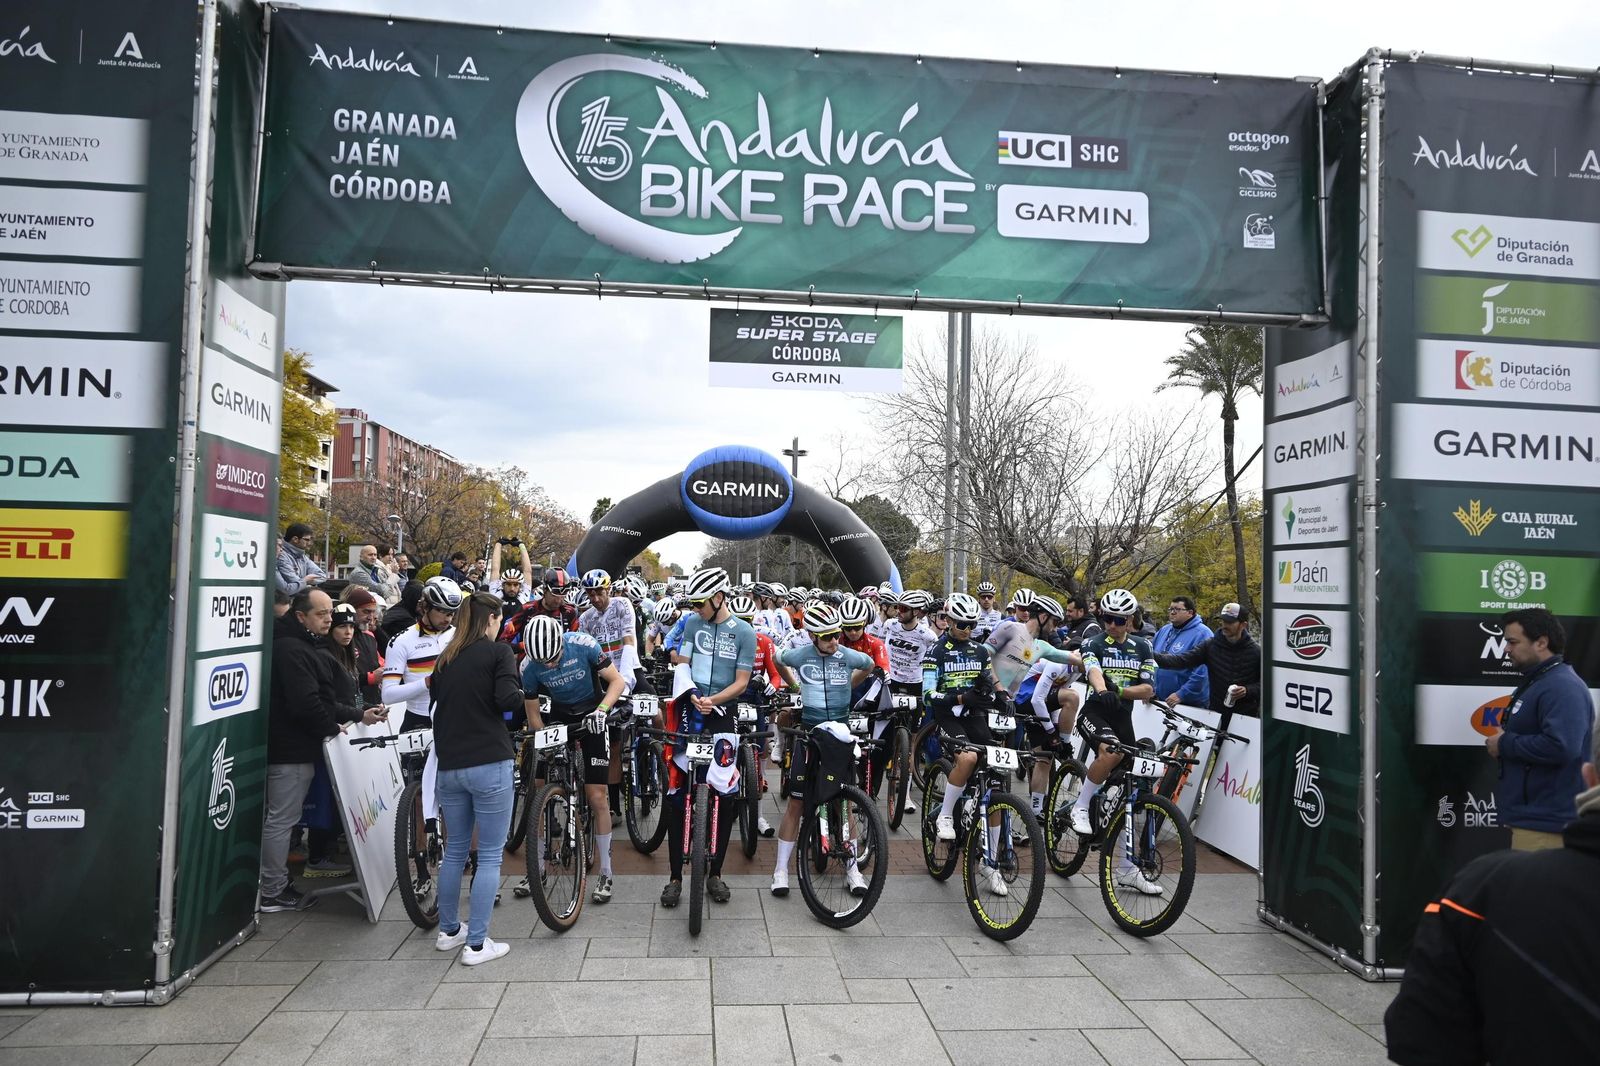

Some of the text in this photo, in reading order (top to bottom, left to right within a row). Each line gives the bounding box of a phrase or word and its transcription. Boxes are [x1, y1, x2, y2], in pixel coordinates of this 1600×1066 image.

[127, 60, 161, 69] Andalucía
[309, 43, 421, 77] Andalucía
[333, 108, 457, 140] GRANADA
[575, 96, 633, 181] 15
[637, 85, 975, 180] Andalucía
[1228, 131, 1290, 151] octagon
[1228, 143, 1260, 152] esedos
[19, 147, 89, 162] GRANADA
[330, 137, 400, 168] JAÉN
[1011, 138, 1119, 164] UCI SHC
[1412, 135, 1538, 177] Andalucía
[575, 154, 617, 165] YEARS
[329, 170, 452, 205] CÓRDOBA
[1239, 190, 1277, 198] CICLISMO
[640, 163, 997, 234] BIKE RACE BY
[1015, 202, 1132, 226] GARMIN
[10, 227, 47, 240] JAÉN
[1497, 236, 1570, 253] Diputación
[1497, 251, 1574, 266] de Granada
[1496, 306, 1546, 317] DIPUTACIÓN
[1496, 315, 1530, 325] DE JAÉN
[736, 327, 878, 345] SUPER STAGE
[772, 343, 842, 362] CÓRDOBA
[1500, 361, 1571, 377] Diputación
[772, 371, 841, 385] GARMIN
[1500, 377, 1572, 391] de Córdoba
[211, 382, 271, 425] GARMIN
[1274, 431, 1346, 463] GARMIN
[1434, 429, 1593, 462] GARMIN
[228, 464, 266, 489] IMDECO
[692, 480, 781, 498] GARMIN
[1297, 516, 1321, 524] Municipal
[1501, 511, 1577, 526] CAJA RURAL
[599, 524, 642, 538] garmin.com
[829, 531, 870, 544] garmin.com
[1297, 527, 1320, 536] Deportes
[1524, 526, 1556, 539] JAÉN
[1293, 560, 1328, 583] Jaén
[1316, 584, 1339, 593] INTERIOR
[211, 596, 253, 618] POWER
[1480, 601, 1506, 609] SPORT
[228, 618, 252, 639] ADE
[889, 639, 920, 652] KTM
[211, 671, 244, 703] CRUZ
[639, 701, 652, 713] 9-1
[898, 697, 910, 707] 6-1
[995, 716, 1009, 727] 4-2
[543, 729, 560, 744] 1-2
[1186, 725, 1201, 737] 4-1
[407, 733, 424, 749] 1-1
[695, 745, 714, 755] 3-2
[995, 750, 1011, 764] 8-2
[1140, 760, 1156, 776] 8-1
[32, 794, 70, 802] UCI SHC
[1294, 798, 1316, 812] YEARS
[208, 801, 228, 818] YEARS
[34, 815, 79, 823] GARMIN
[1464, 812, 1499, 828] BIKE
